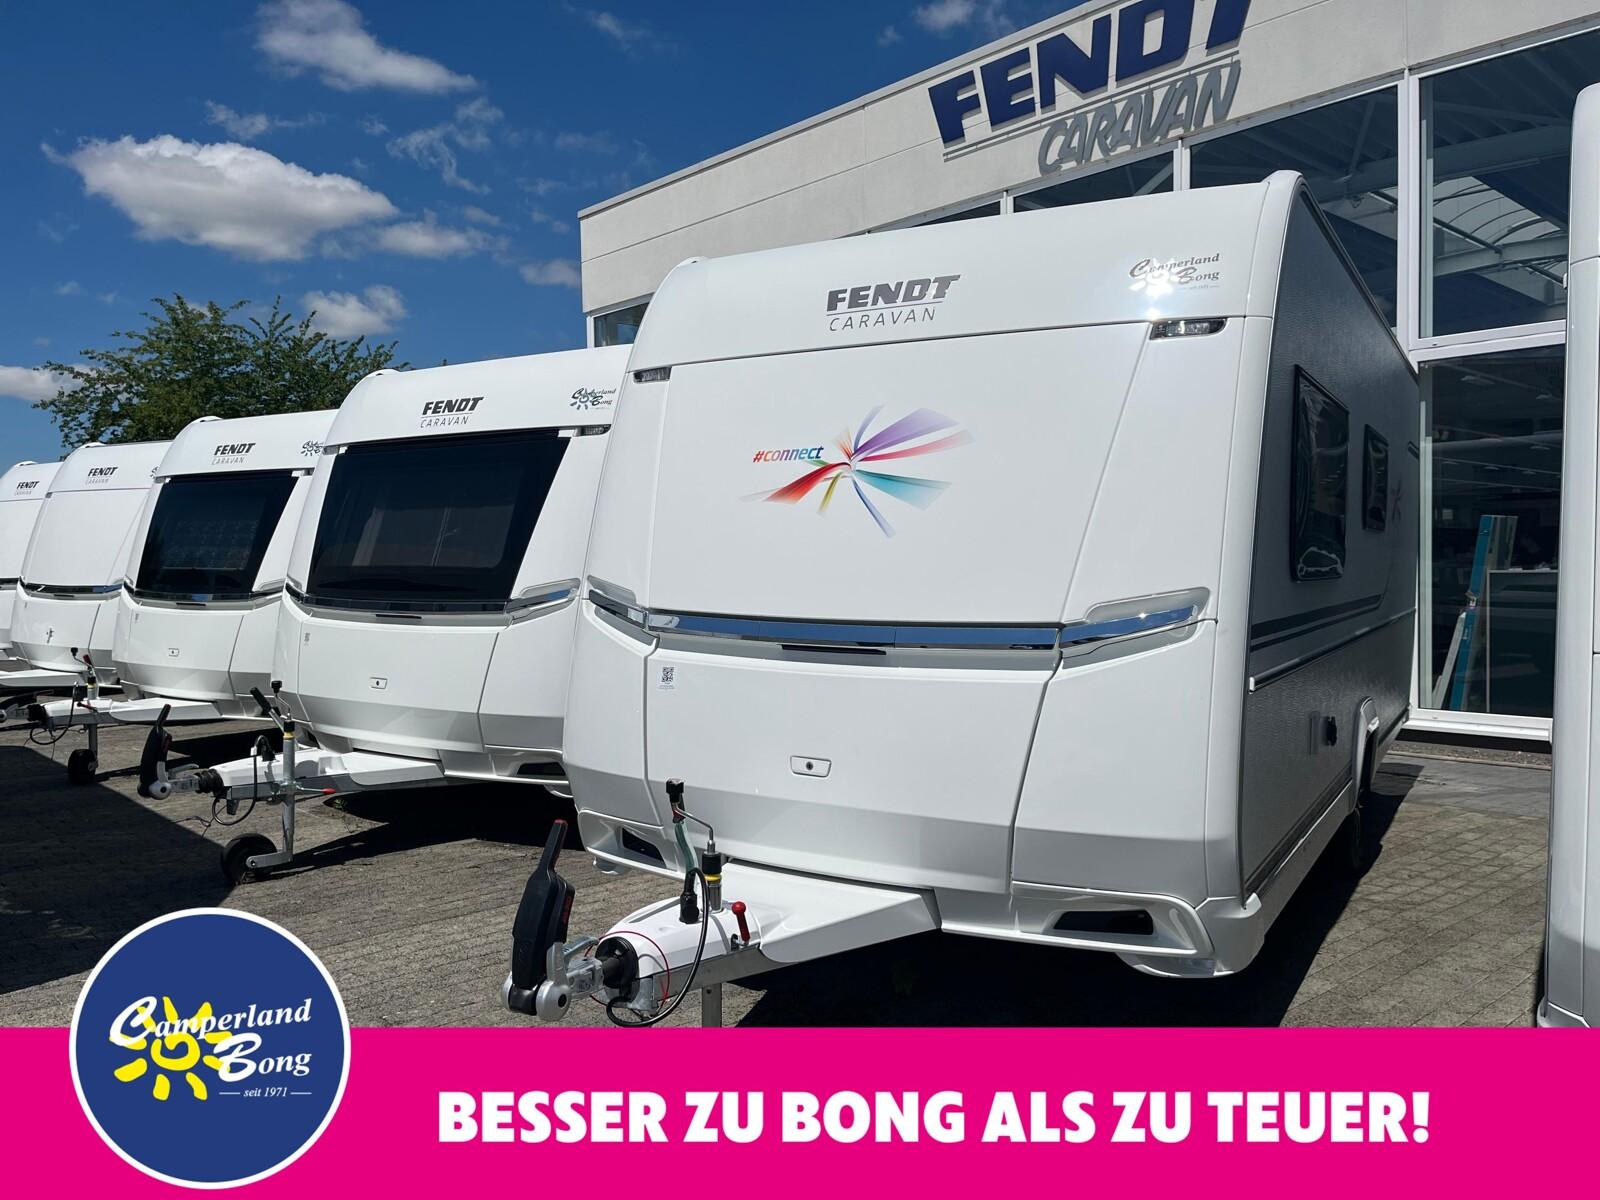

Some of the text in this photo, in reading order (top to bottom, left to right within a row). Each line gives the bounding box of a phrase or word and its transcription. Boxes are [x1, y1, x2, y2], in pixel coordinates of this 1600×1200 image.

[1038, 59, 1240, 176] CARAVAN
[1176, 266, 1220, 285] Bong
[826, 274, 961, 312] FENDT
[829, 307, 936, 332] CARAVAN
[422, 396, 485, 416] FENDT
[420, 415, 470, 429] CARAVAN
[214, 443, 256, 456] FENDT
[752, 445, 825, 463] #connect
[88, 466, 118, 477] FENDT
